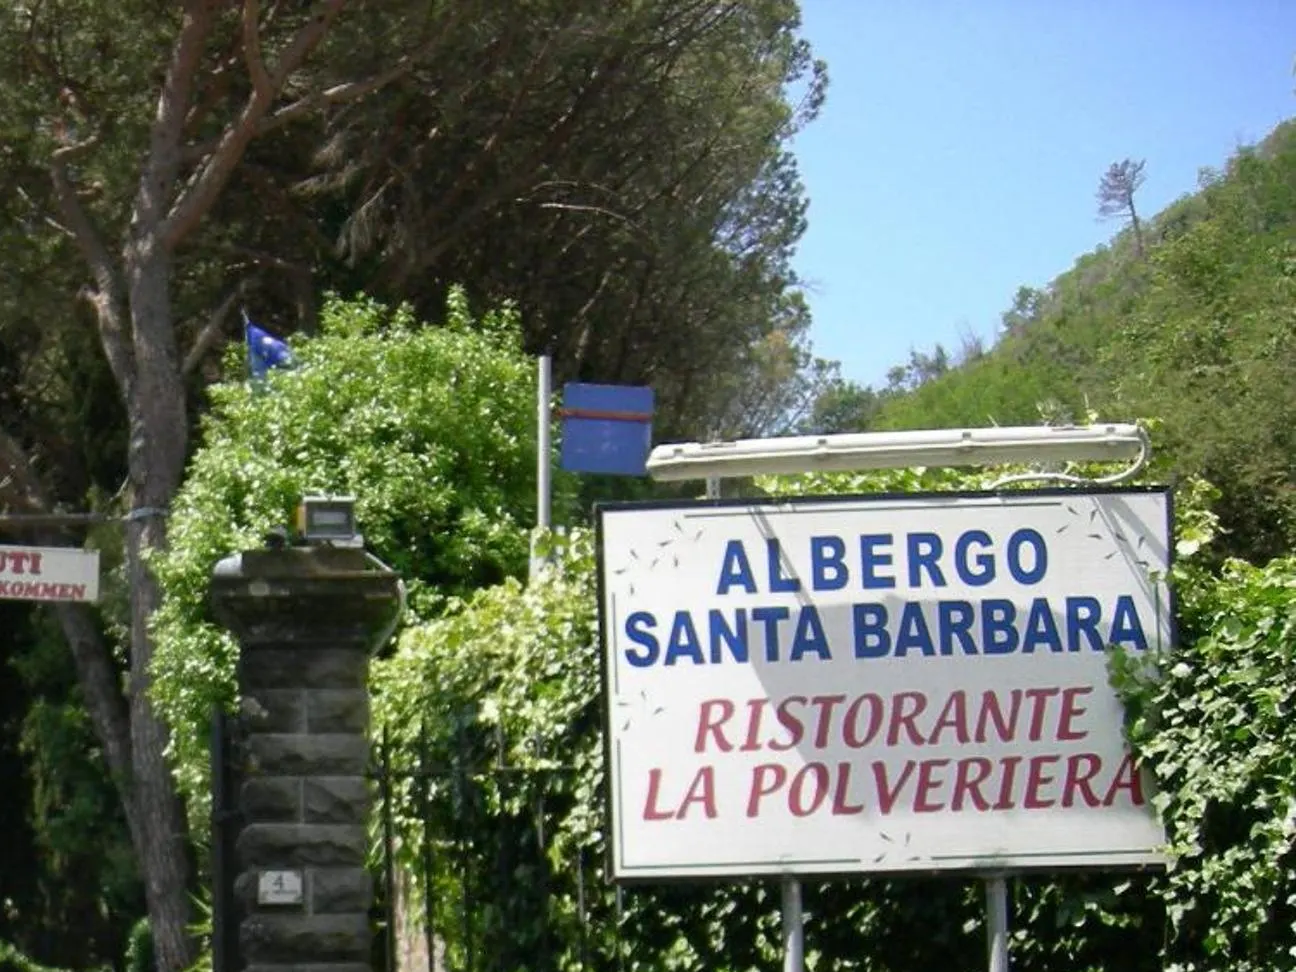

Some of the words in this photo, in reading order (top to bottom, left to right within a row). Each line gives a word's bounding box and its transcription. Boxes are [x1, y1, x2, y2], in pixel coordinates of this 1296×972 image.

[717, 527, 1050, 595] ALBERGO
[624, 603, 832, 668] SANTA
[852, 595, 1147, 659] BARBARA
[694, 686, 1094, 754] RISTORANTE
[643, 765, 718, 821] LA
[746, 752, 1146, 819] POLVERIERA
